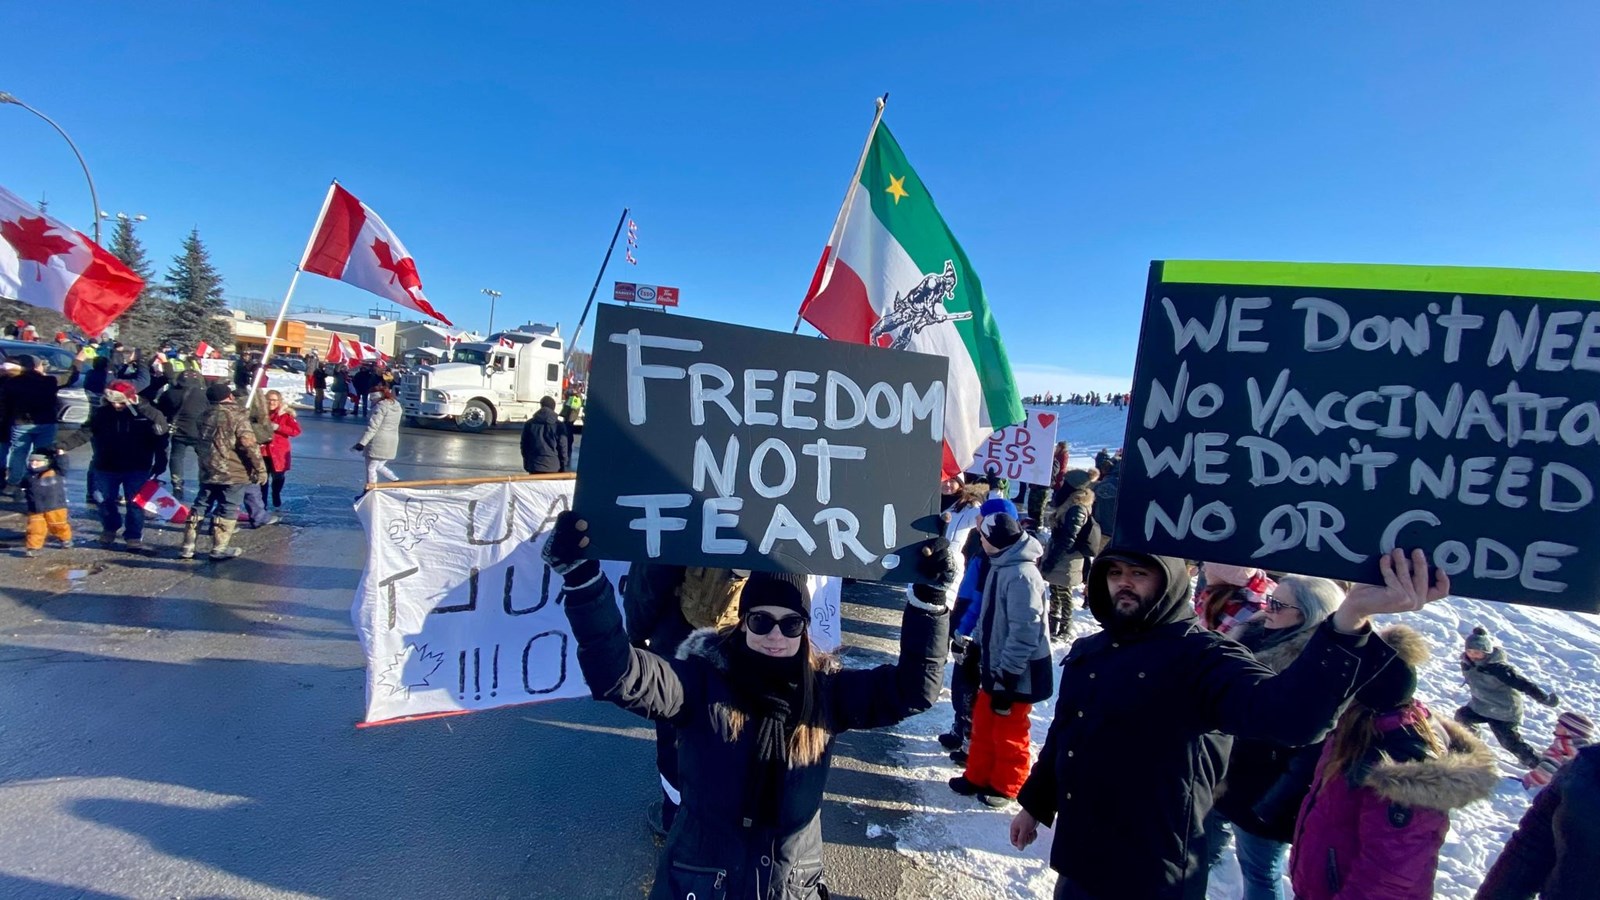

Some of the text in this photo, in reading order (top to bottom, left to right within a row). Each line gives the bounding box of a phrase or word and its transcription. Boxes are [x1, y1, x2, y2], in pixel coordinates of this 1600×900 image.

[1162, 295, 1272, 355] WE
[608, 327, 945, 442] FREEDOM
[1143, 360, 1600, 449] NO VACCINATIO
[692, 434, 867, 505] NOT
[974, 441, 1036, 465] ESS
[983, 458, 1022, 479] OU
[988, 427, 1031, 446] OD
[1137, 431, 1230, 485] WE
[1409, 454, 1594, 513] NEED
[615, 493, 900, 570] FEAR!
[1144, 494, 1236, 543] NO
[1250, 500, 1369, 564] QR
